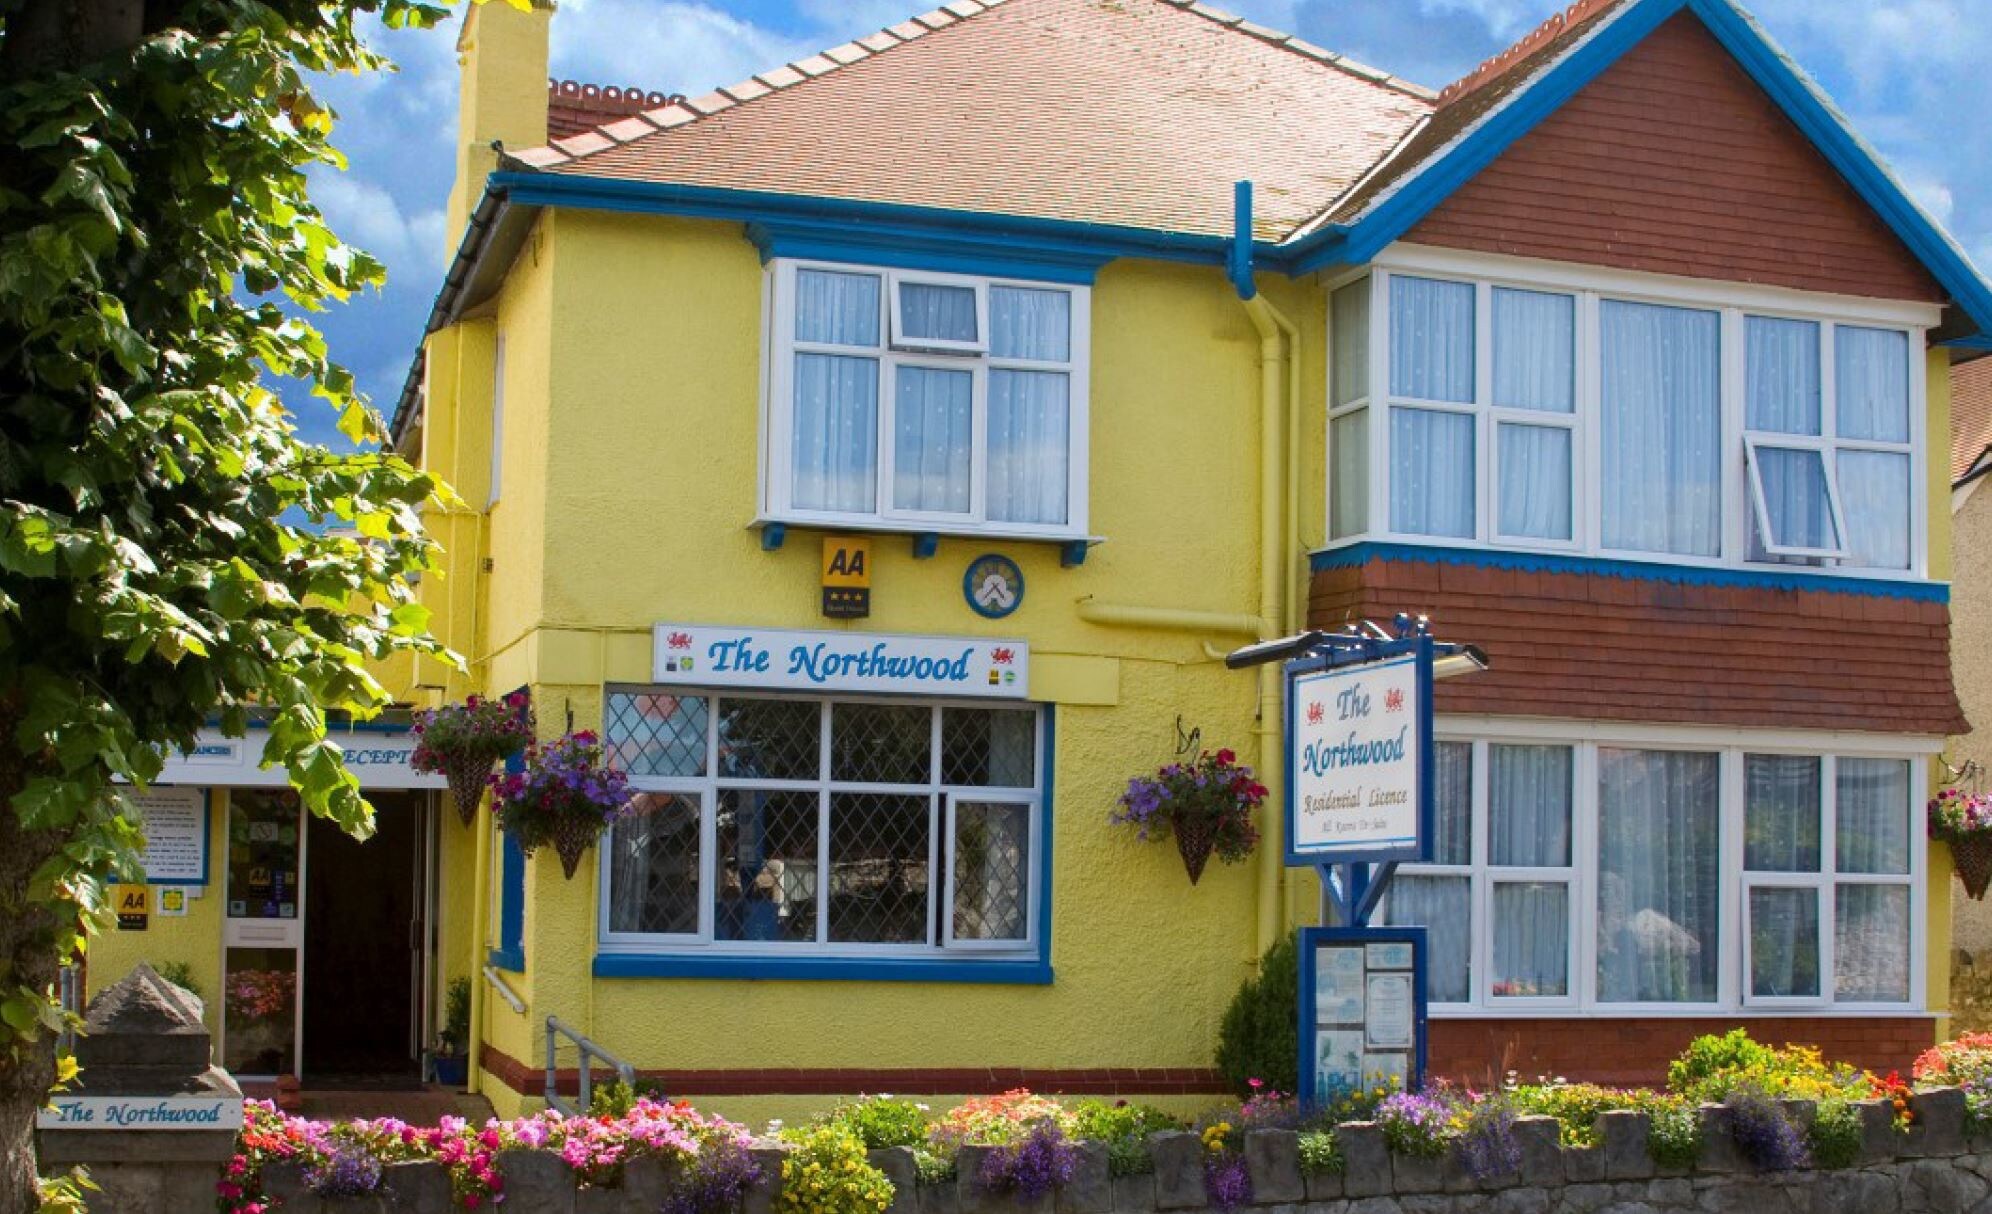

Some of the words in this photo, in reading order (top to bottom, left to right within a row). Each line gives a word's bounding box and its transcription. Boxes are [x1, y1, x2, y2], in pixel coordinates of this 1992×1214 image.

[828, 548, 864, 576] AA
[708, 637, 769, 672] The
[787, 642, 974, 683] Northwood
[1337, 682, 1371, 721] The
[343, 749, 411, 764] ECEPT
[1303, 724, 1408, 778] Northwood
[1304, 785, 1362, 816] Residential
[1368, 787, 1407, 808] Licence
[122, 892, 145, 909] AA
[57, 1102, 94, 1122] The
[105, 1101, 223, 1126] Northwood
